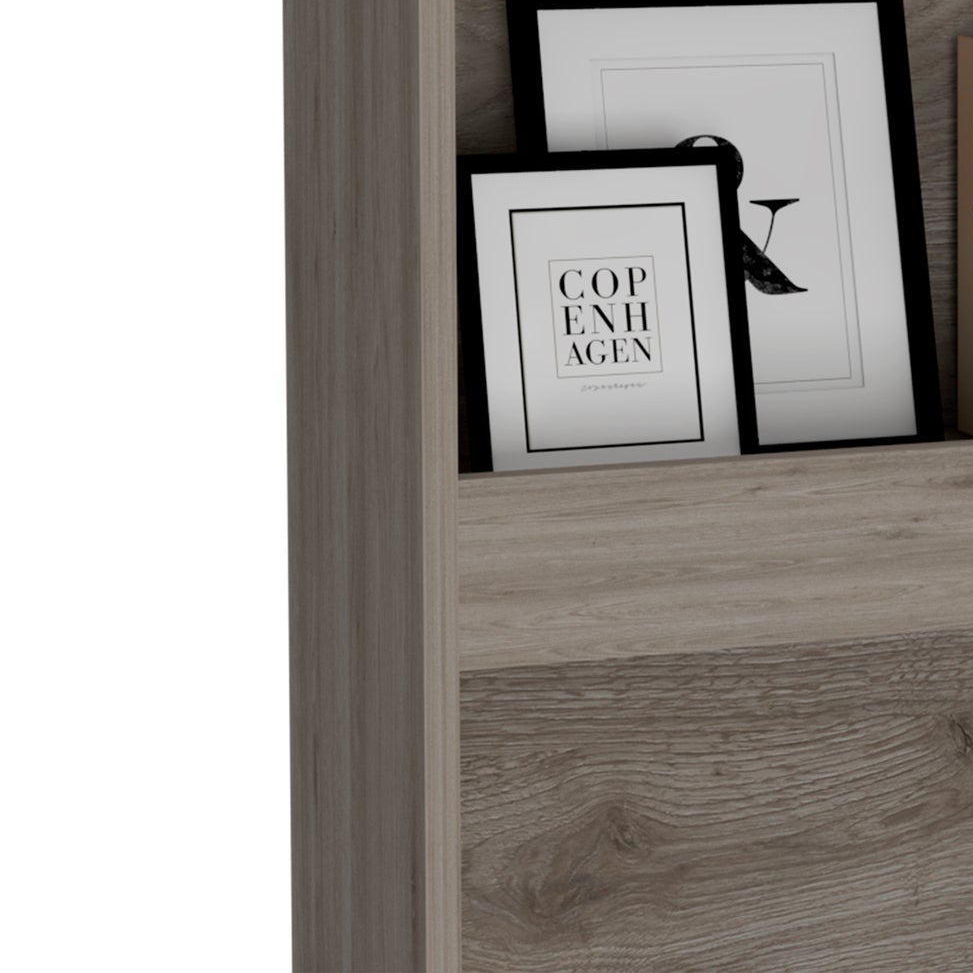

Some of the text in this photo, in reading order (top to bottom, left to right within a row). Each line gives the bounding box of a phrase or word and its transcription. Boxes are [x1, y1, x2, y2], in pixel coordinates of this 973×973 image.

[559, 267, 647, 300] COP
[560, 301, 651, 336] ENH
[564, 336, 652, 366] AGEN
